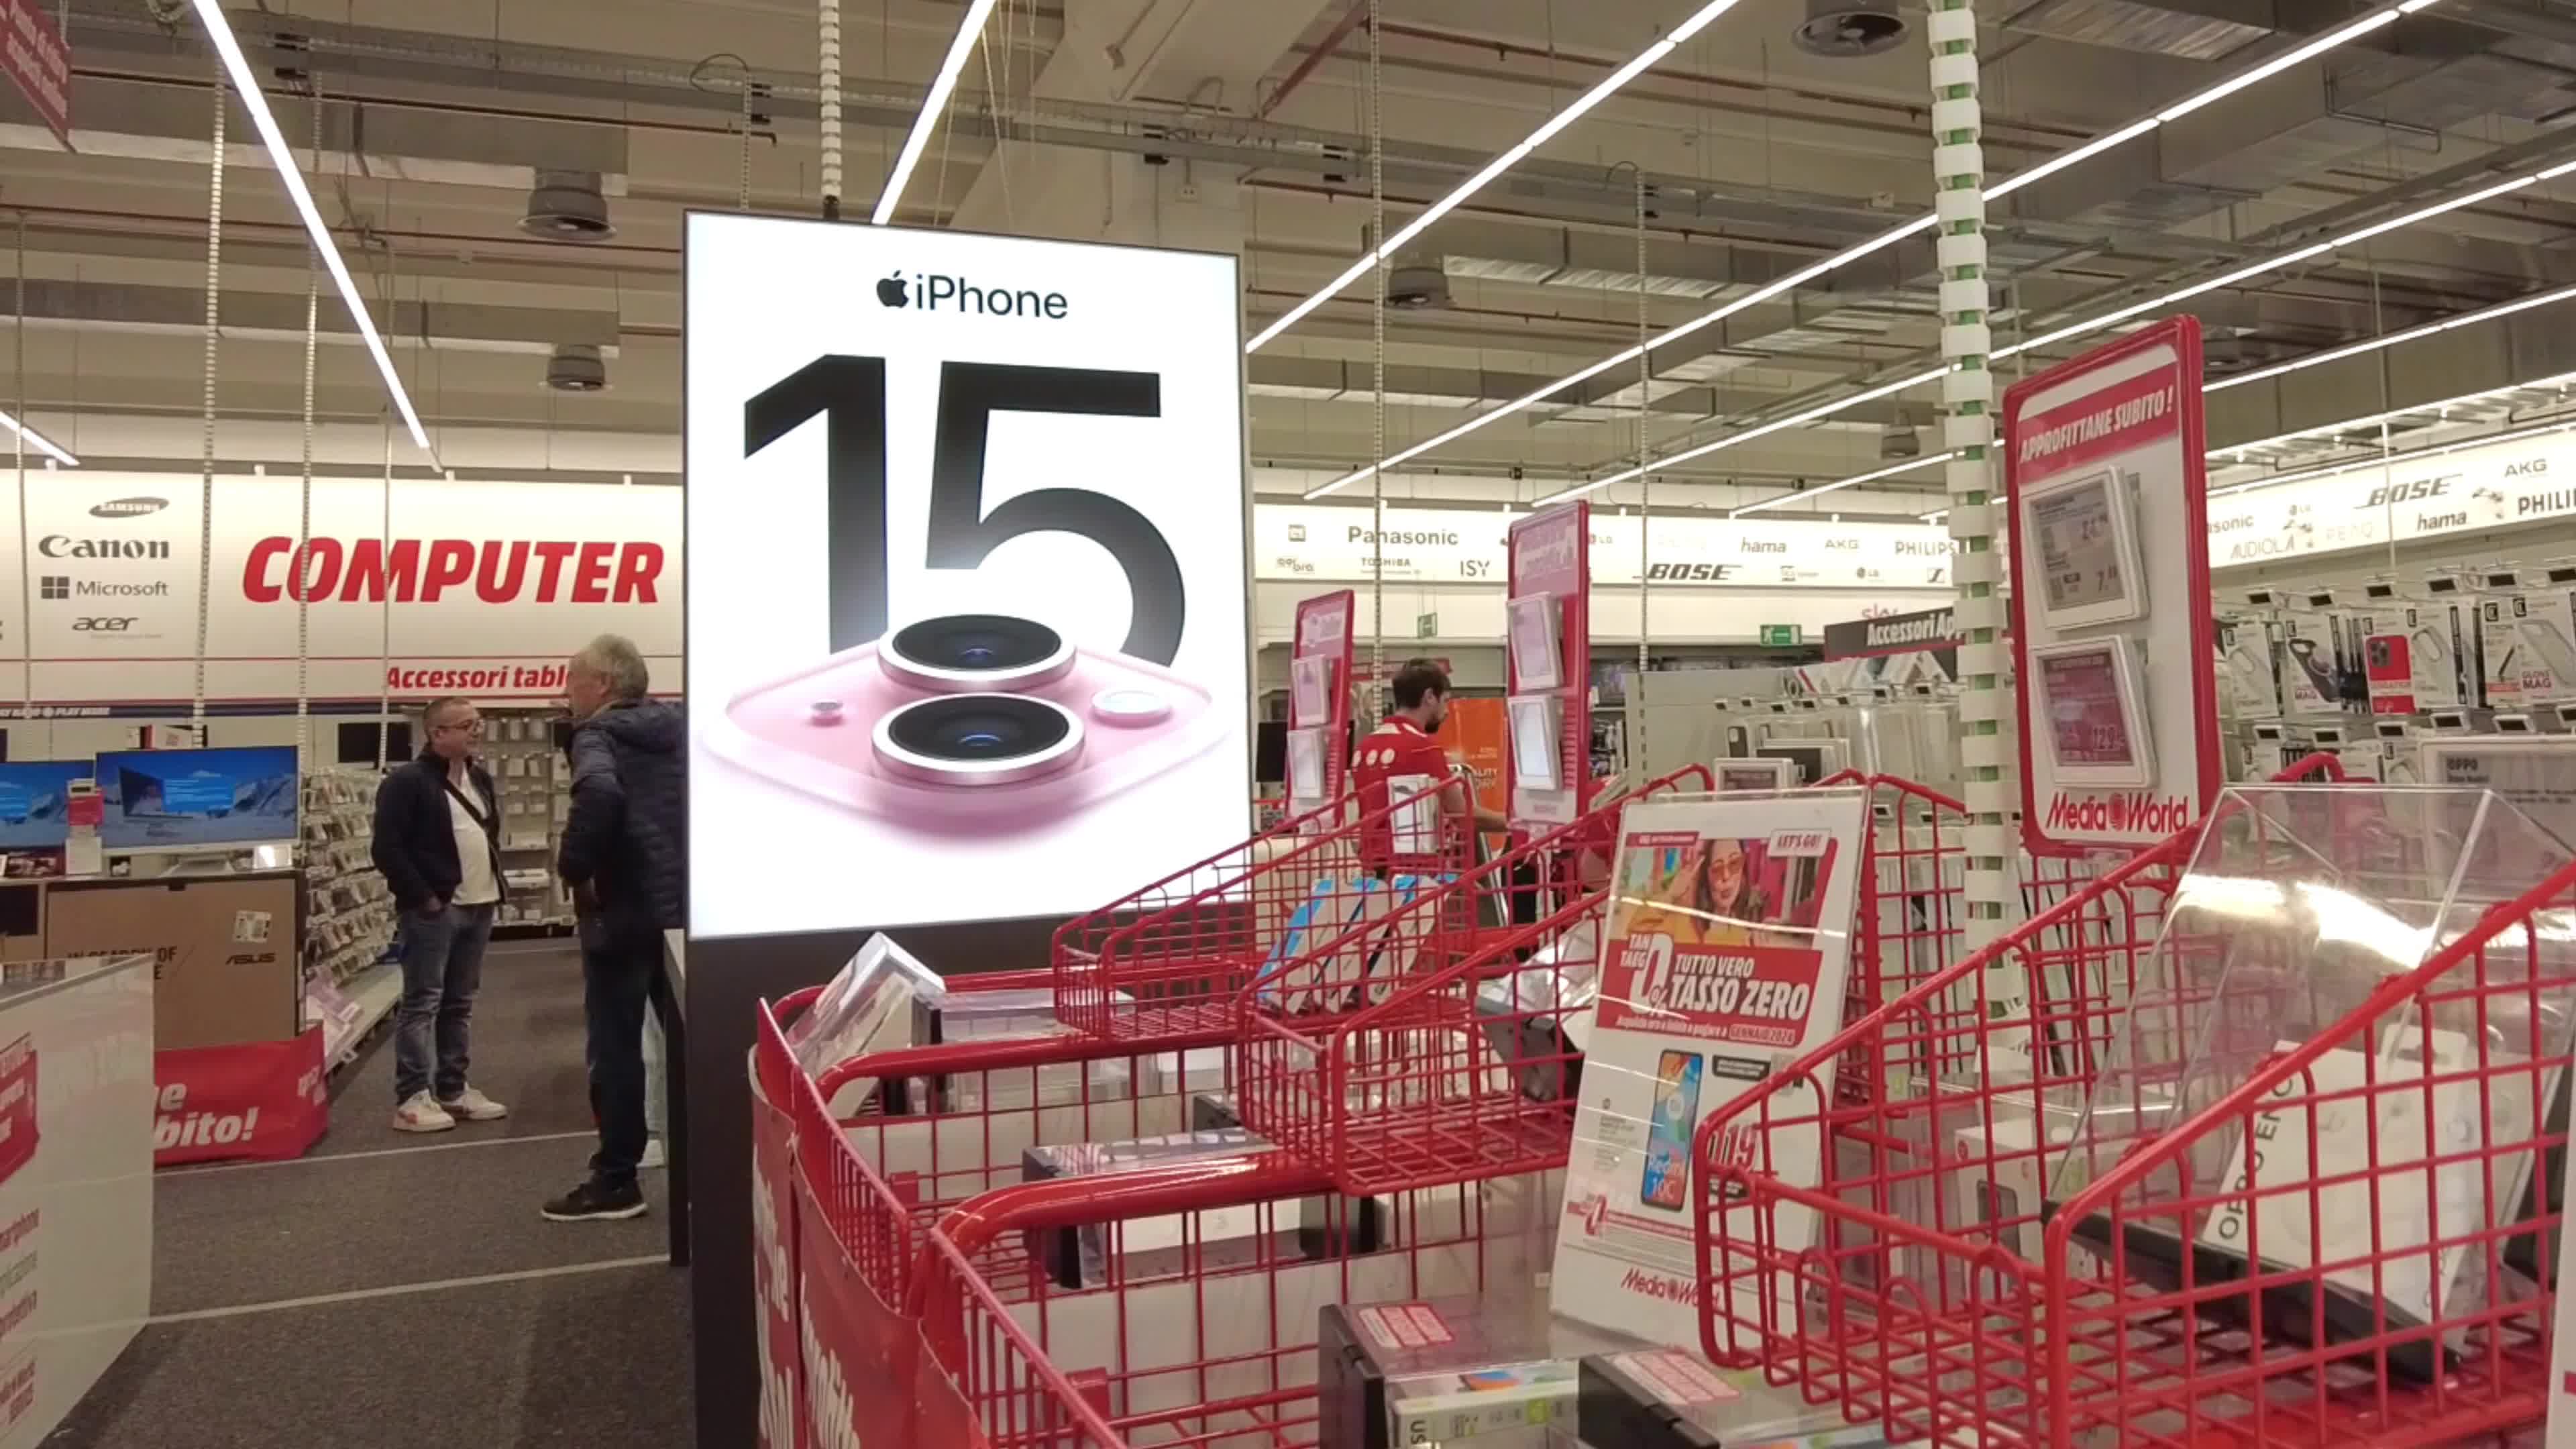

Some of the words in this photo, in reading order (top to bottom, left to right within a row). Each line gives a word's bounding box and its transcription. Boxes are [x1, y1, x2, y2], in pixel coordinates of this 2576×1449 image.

[916, 273, 1068, 319] iPhone
[2020, 407, 2114, 464] APPROFITTANE
[2504, 458, 2547, 478] AKG
[2357, 474, 2461, 508] BOSE
[744, 354, 1185, 667] 15
[2416, 511, 2467, 531] hama
[1348, 525, 1458, 545] Panasonic
[1741, 537, 1786, 553] hama
[1825, 539, 1860, 549] AKG
[38, 535, 169, 559] Canon
[1895, 541, 1956, 556] PHILIPS
[2231, 534, 2295, 560] AUDIOLA
[242, 536, 664, 603] COMPUTER
[1460, 560, 1491, 577] ISY
[1640, 563, 1742, 580] BOSE
[76, 581, 168, 596] Microsoft
[72, 617, 139, 631] acer
[1867, 613, 1935, 646] Accessori
[387, 665, 510, 688] Accessori
[513, 664, 569, 688] tabl
[225, 953, 276, 965] ASUS
[1674, 953, 1718, 975] TUTTO
[1718, 955, 1755, 978] VERO
[1669, 972, 1744, 1014] TASSO
[1739, 979, 1810, 1020] ZERO
